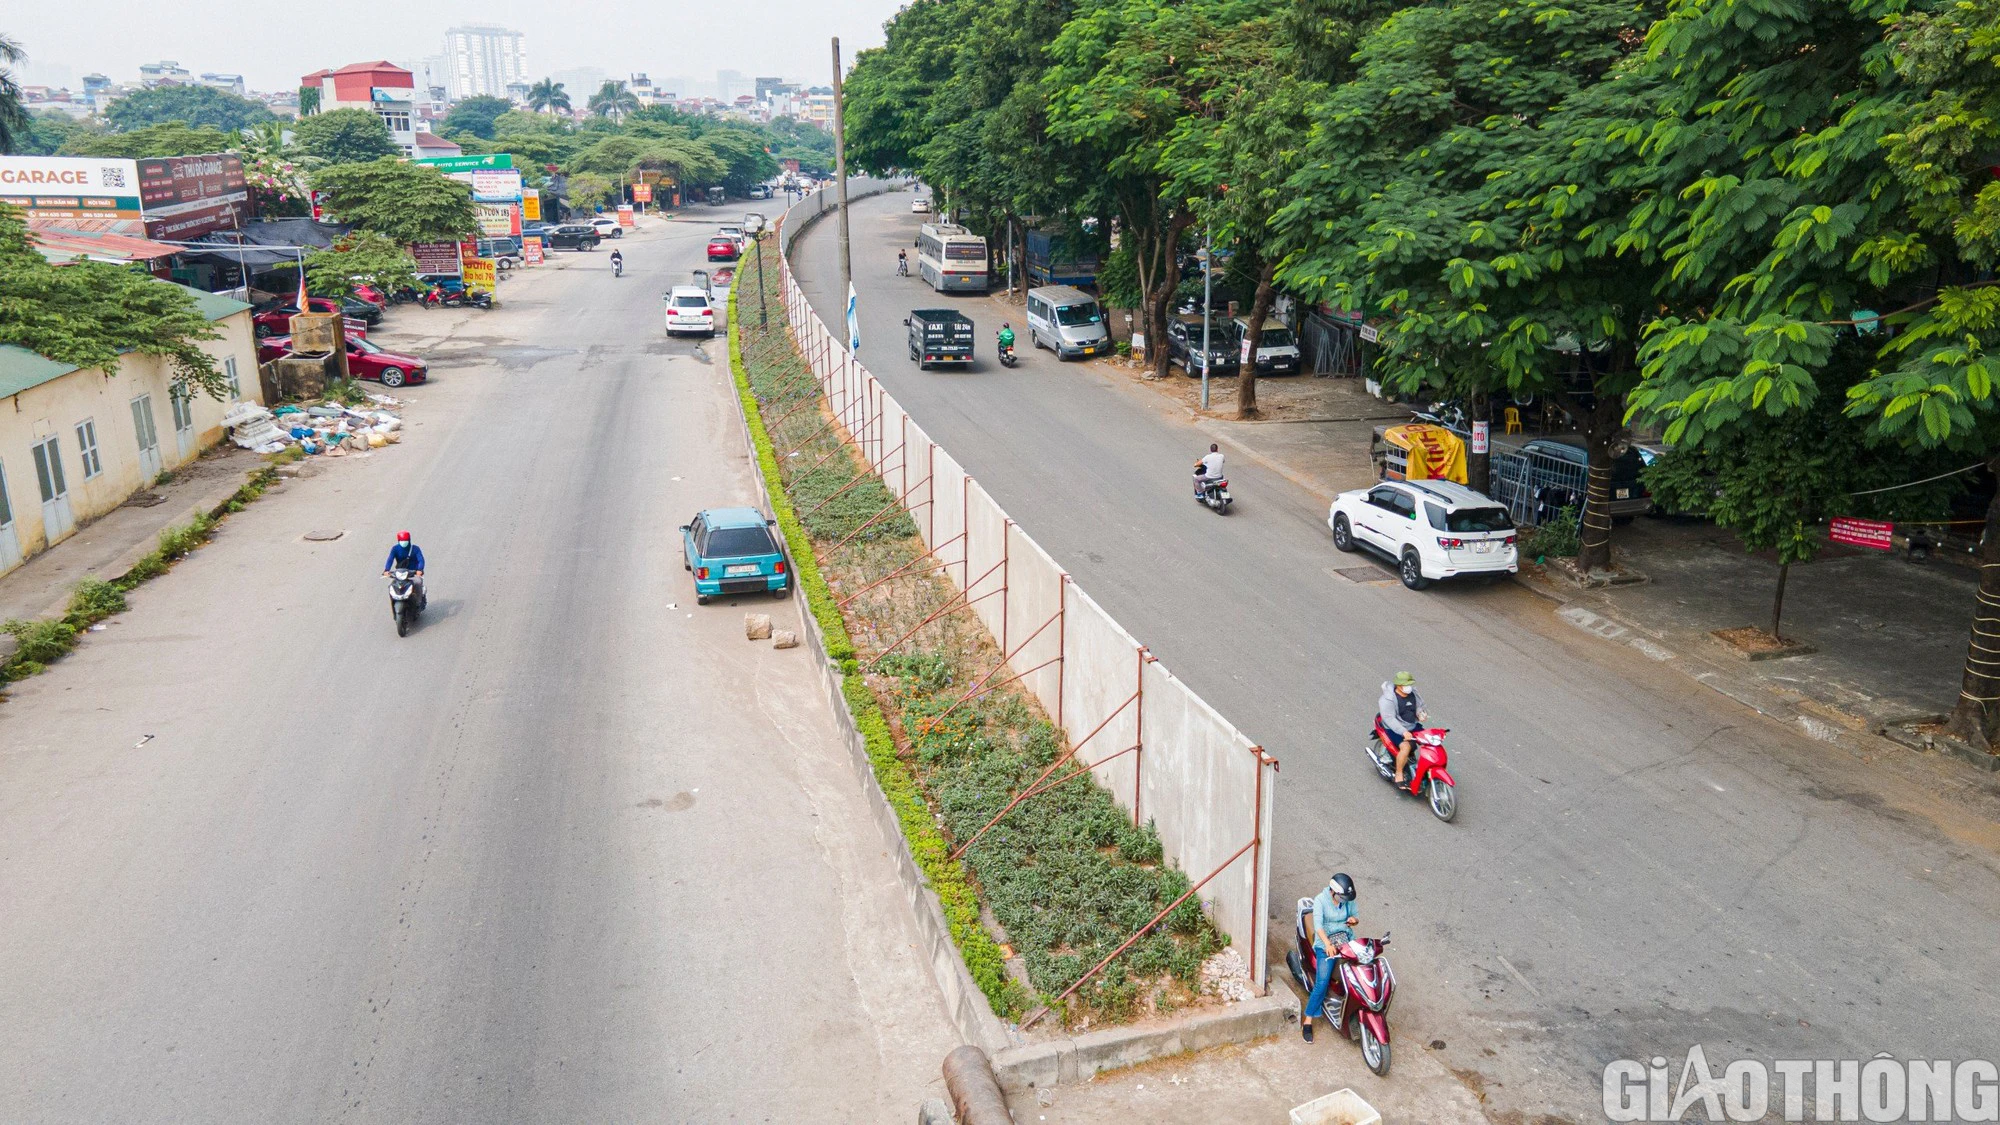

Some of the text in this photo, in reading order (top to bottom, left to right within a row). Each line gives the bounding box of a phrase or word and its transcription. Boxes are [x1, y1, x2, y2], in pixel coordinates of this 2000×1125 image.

[1, 170, 88, 184] GARAGE
[928, 323, 943, 331] TAXI
[1419, 430, 1446, 480] KINH
